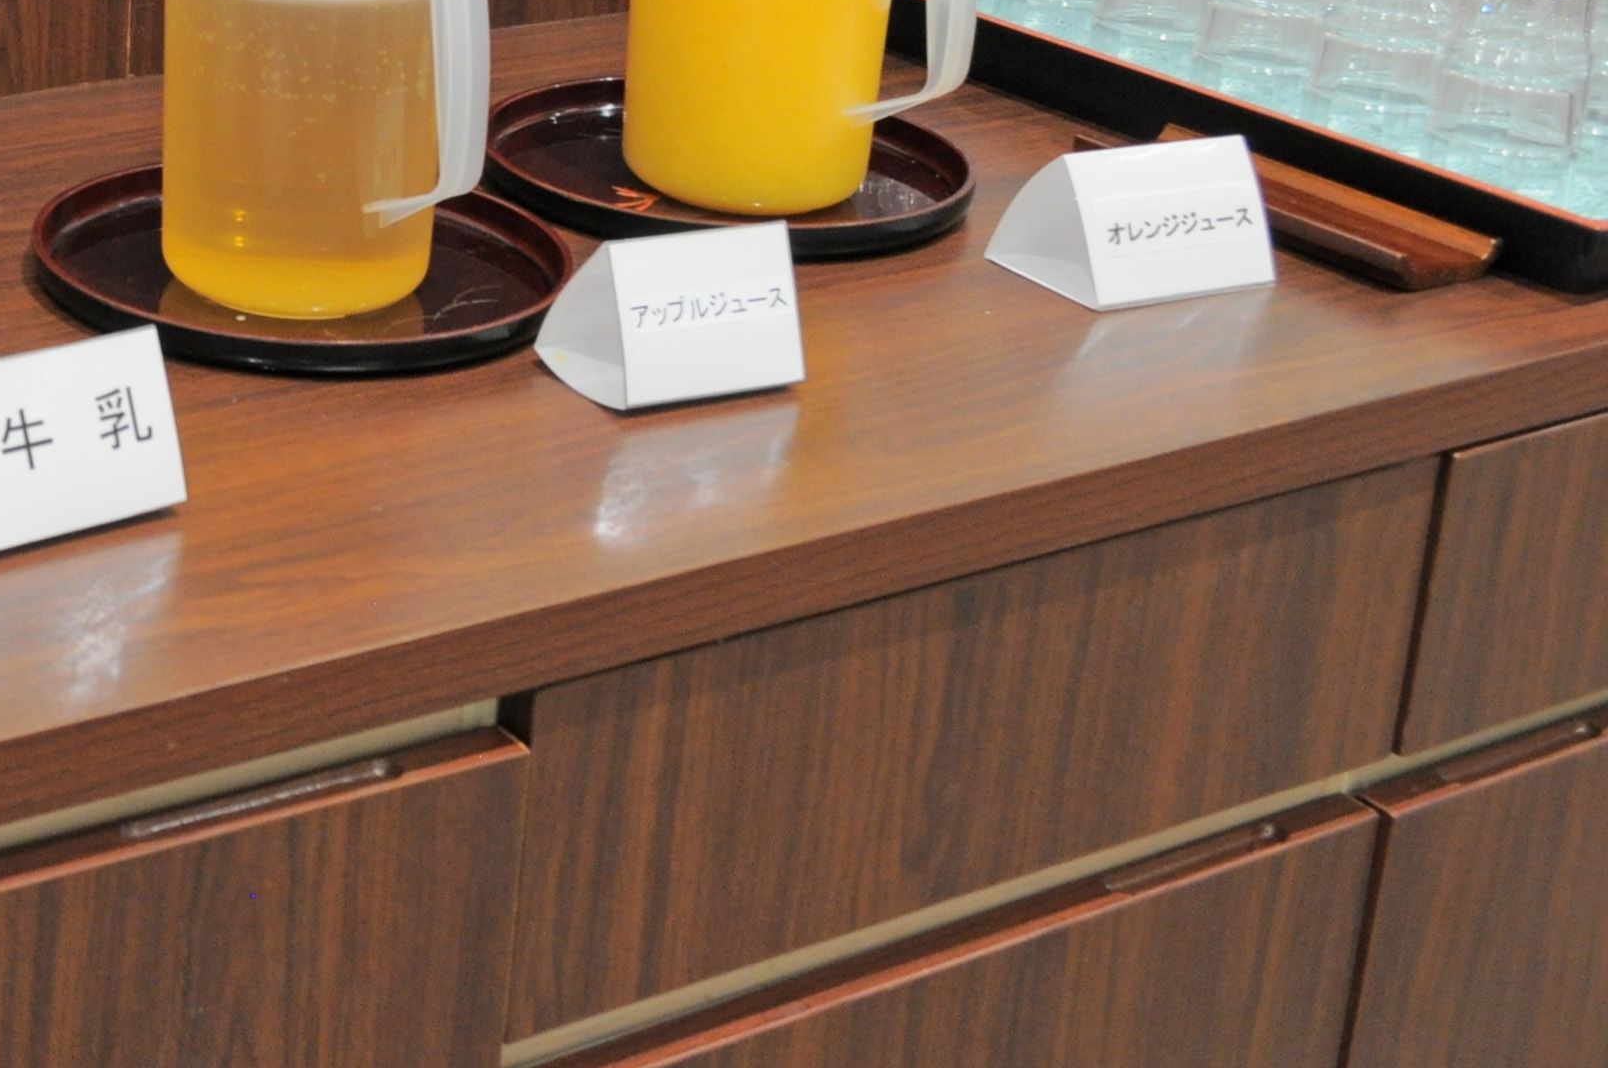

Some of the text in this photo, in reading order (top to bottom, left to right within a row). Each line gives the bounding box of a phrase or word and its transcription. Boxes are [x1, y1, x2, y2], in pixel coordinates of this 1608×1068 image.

[1107, 208, 1253, 246] オレンジジュース
[630, 287, 788, 329] アップルジュース
[1, 386, 153, 470] 牛乳
